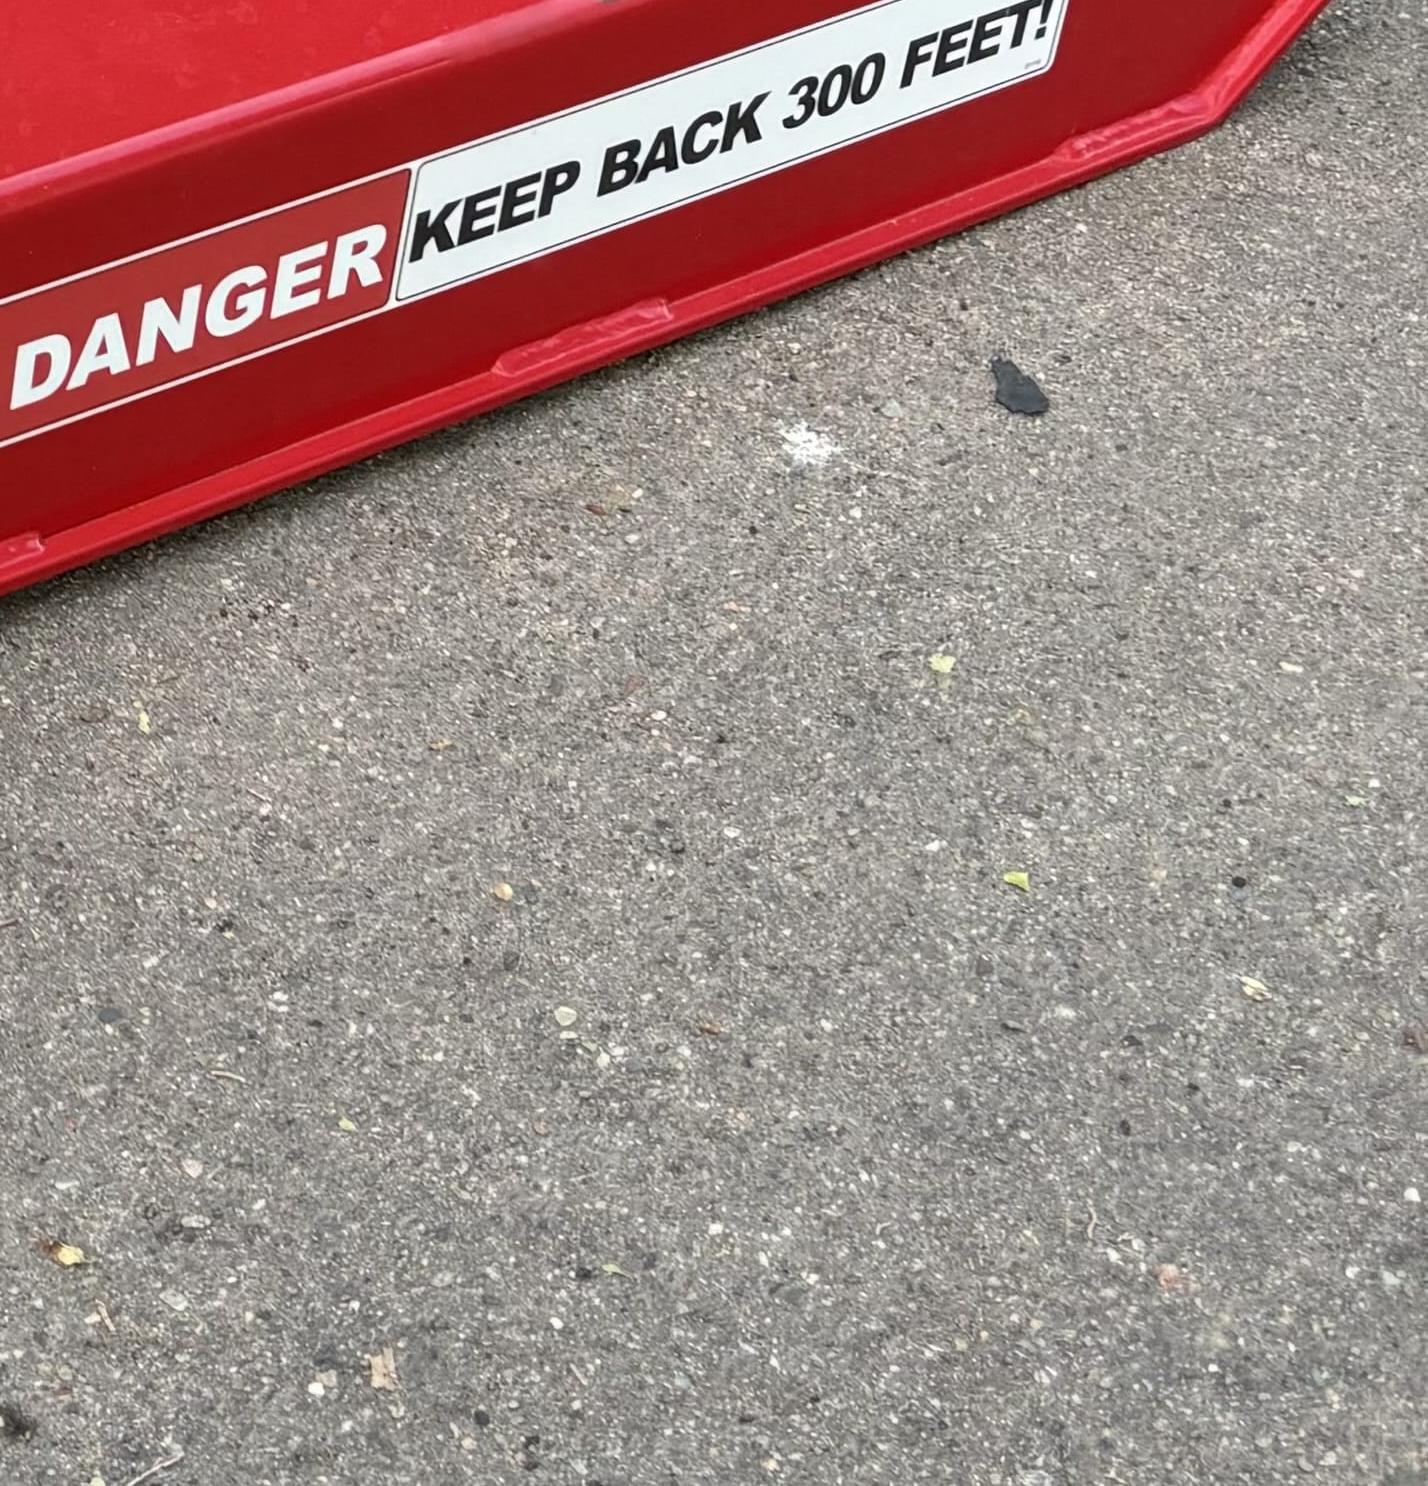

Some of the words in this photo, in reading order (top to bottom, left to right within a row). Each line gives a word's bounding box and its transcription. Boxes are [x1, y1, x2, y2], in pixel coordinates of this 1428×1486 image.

[9, 220, 390, 411] DANGER
[407, 159, 585, 265] KEEP
[595, 92, 772, 200] BACK
[781, 50, 887, 131] 300
